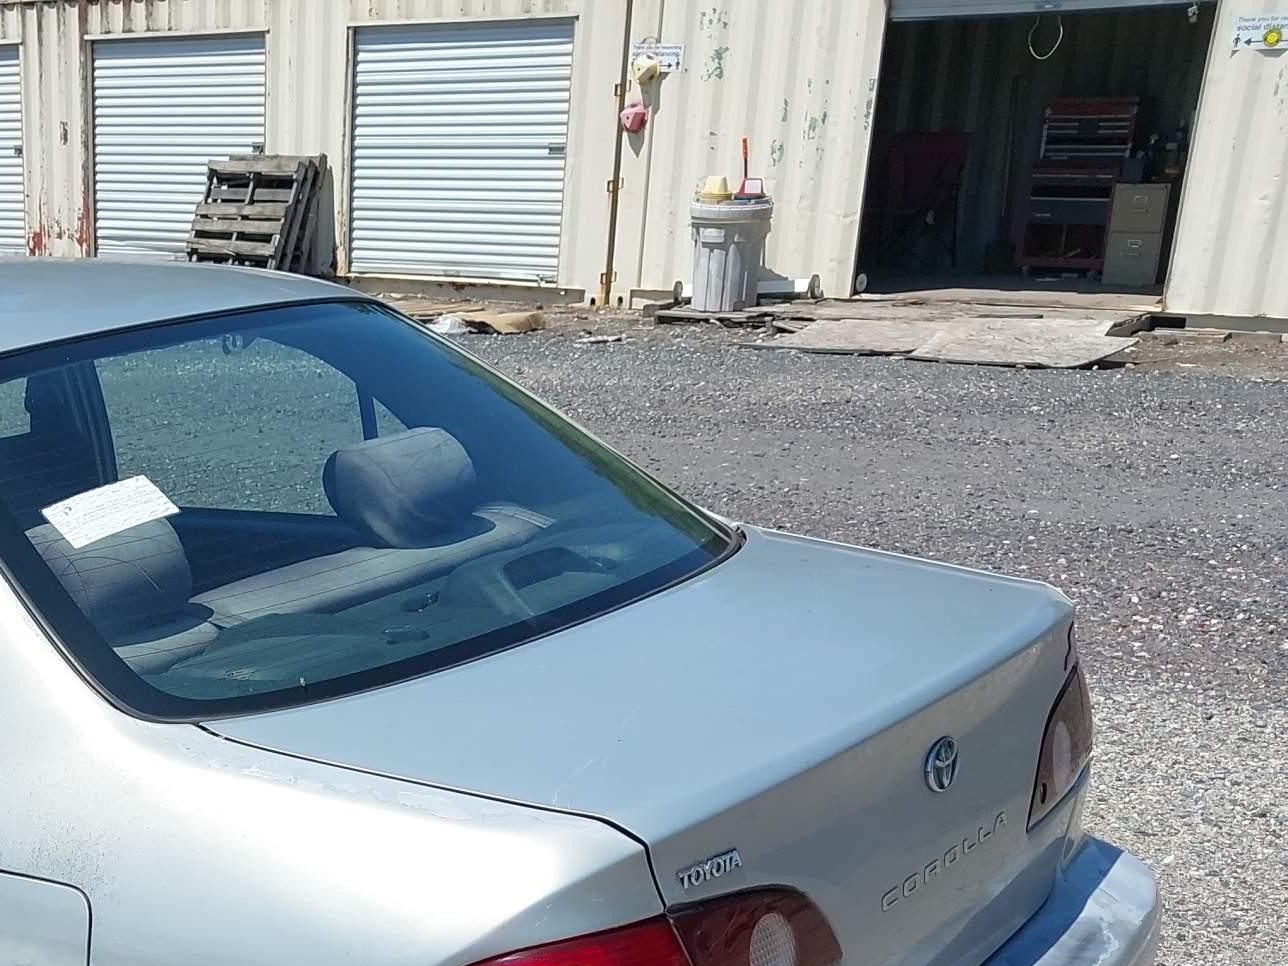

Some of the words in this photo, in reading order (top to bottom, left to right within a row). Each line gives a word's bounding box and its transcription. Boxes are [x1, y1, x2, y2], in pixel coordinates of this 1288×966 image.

[1237, 23, 1262, 31] social
[677, 850, 742, 890] TOYOTA
[880, 811, 1008, 913] COROLLA
